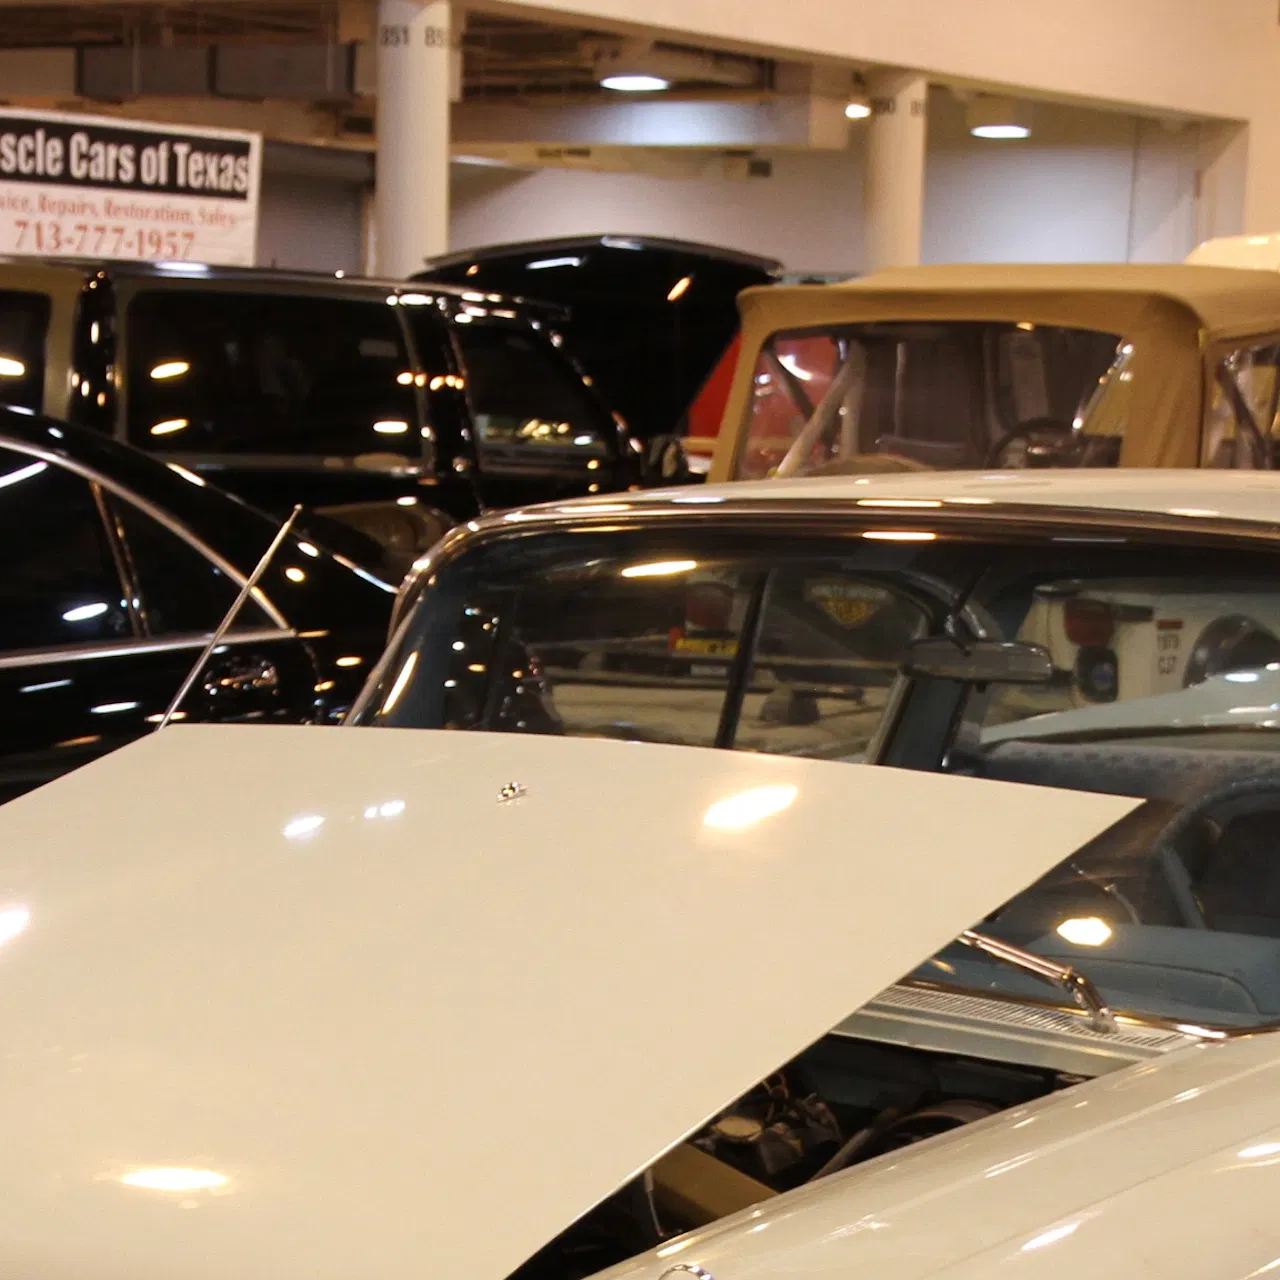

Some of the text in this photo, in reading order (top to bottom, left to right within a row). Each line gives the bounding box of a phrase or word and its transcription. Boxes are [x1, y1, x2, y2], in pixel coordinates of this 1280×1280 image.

[69, 132, 135, 183] Cars
[140, 140, 172, 186] of
[174, 146, 250, 194] Texas
[37, 193, 99, 218] Repairs,
[104, 198, 194, 225] Restoration,
[14, 219, 196, 259] 713-777-1957
